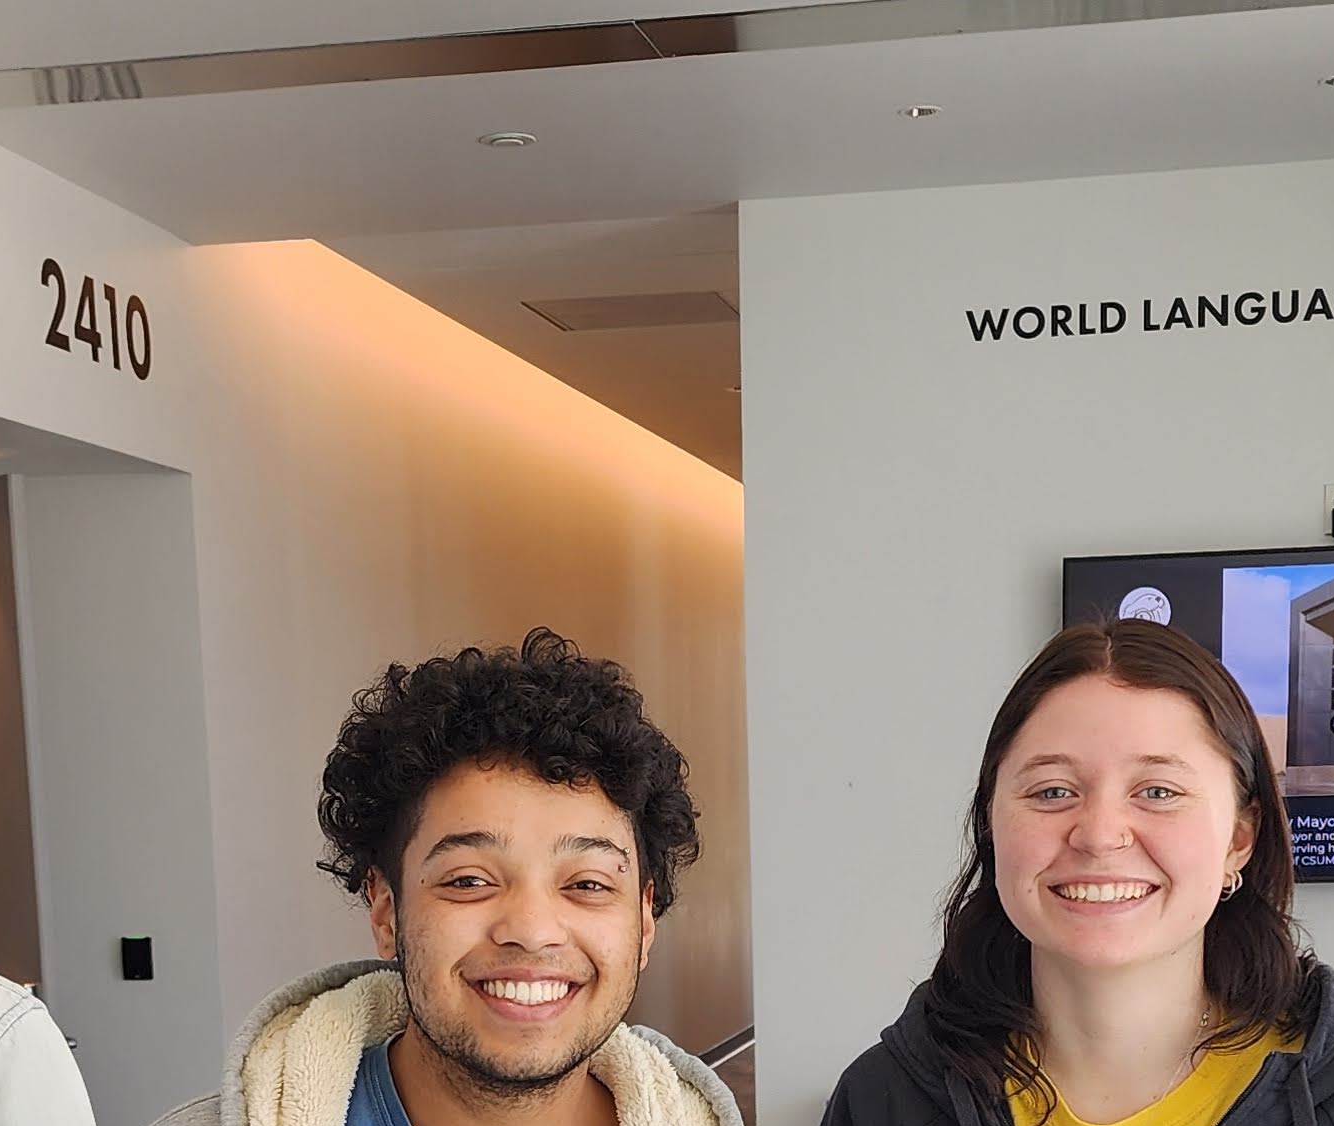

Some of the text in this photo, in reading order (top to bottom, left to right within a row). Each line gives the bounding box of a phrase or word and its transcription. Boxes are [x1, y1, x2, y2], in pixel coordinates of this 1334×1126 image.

[41, 258, 151, 381] 2410
[965, 301, 1127, 342] WORLD
[1291, 832, 1313, 843] ayor
[1291, 843, 1325, 855] erving
